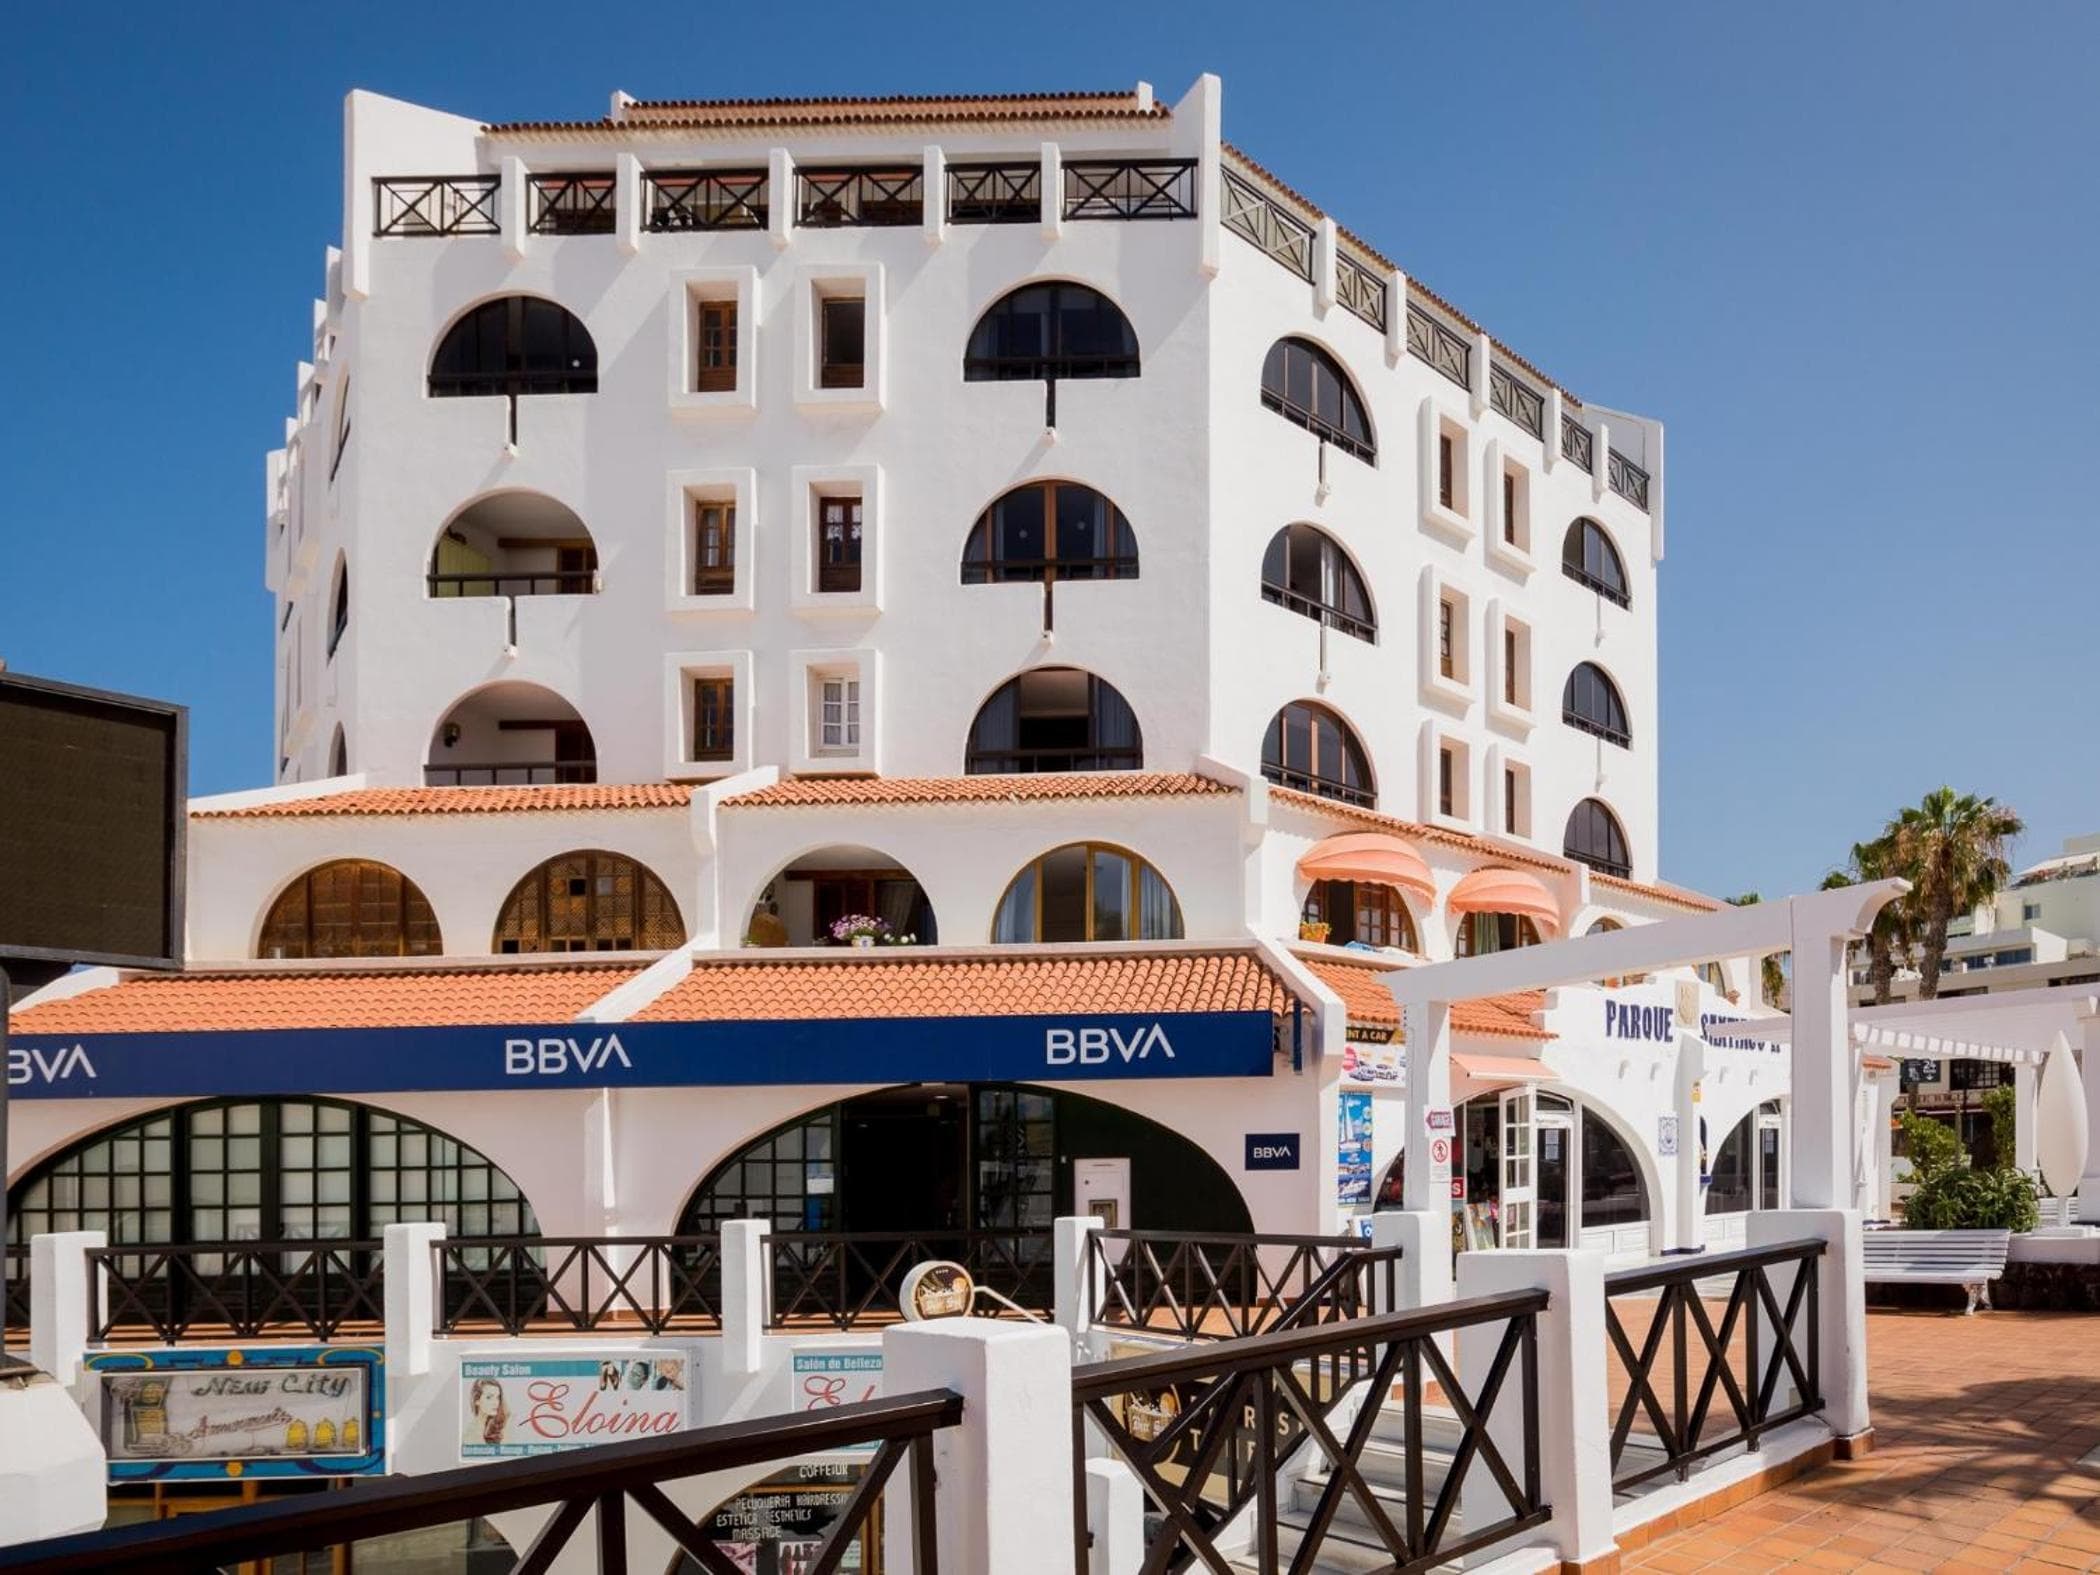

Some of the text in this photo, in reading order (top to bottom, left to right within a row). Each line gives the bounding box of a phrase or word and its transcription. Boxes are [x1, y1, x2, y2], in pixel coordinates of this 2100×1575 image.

[1605, 999, 1673, 1042] PARQUE
[505, 1033, 633, 1074] BBVA
[1046, 1022, 1176, 1065] BBVA
[8, 1044, 97, 1085] BVA
[1253, 1145, 1291, 1159] BBVA
[280, 1373, 349, 1398] City
[464, 1364, 531, 1377] Beauty Salon
[519, 1380, 680, 1439] Eloina
